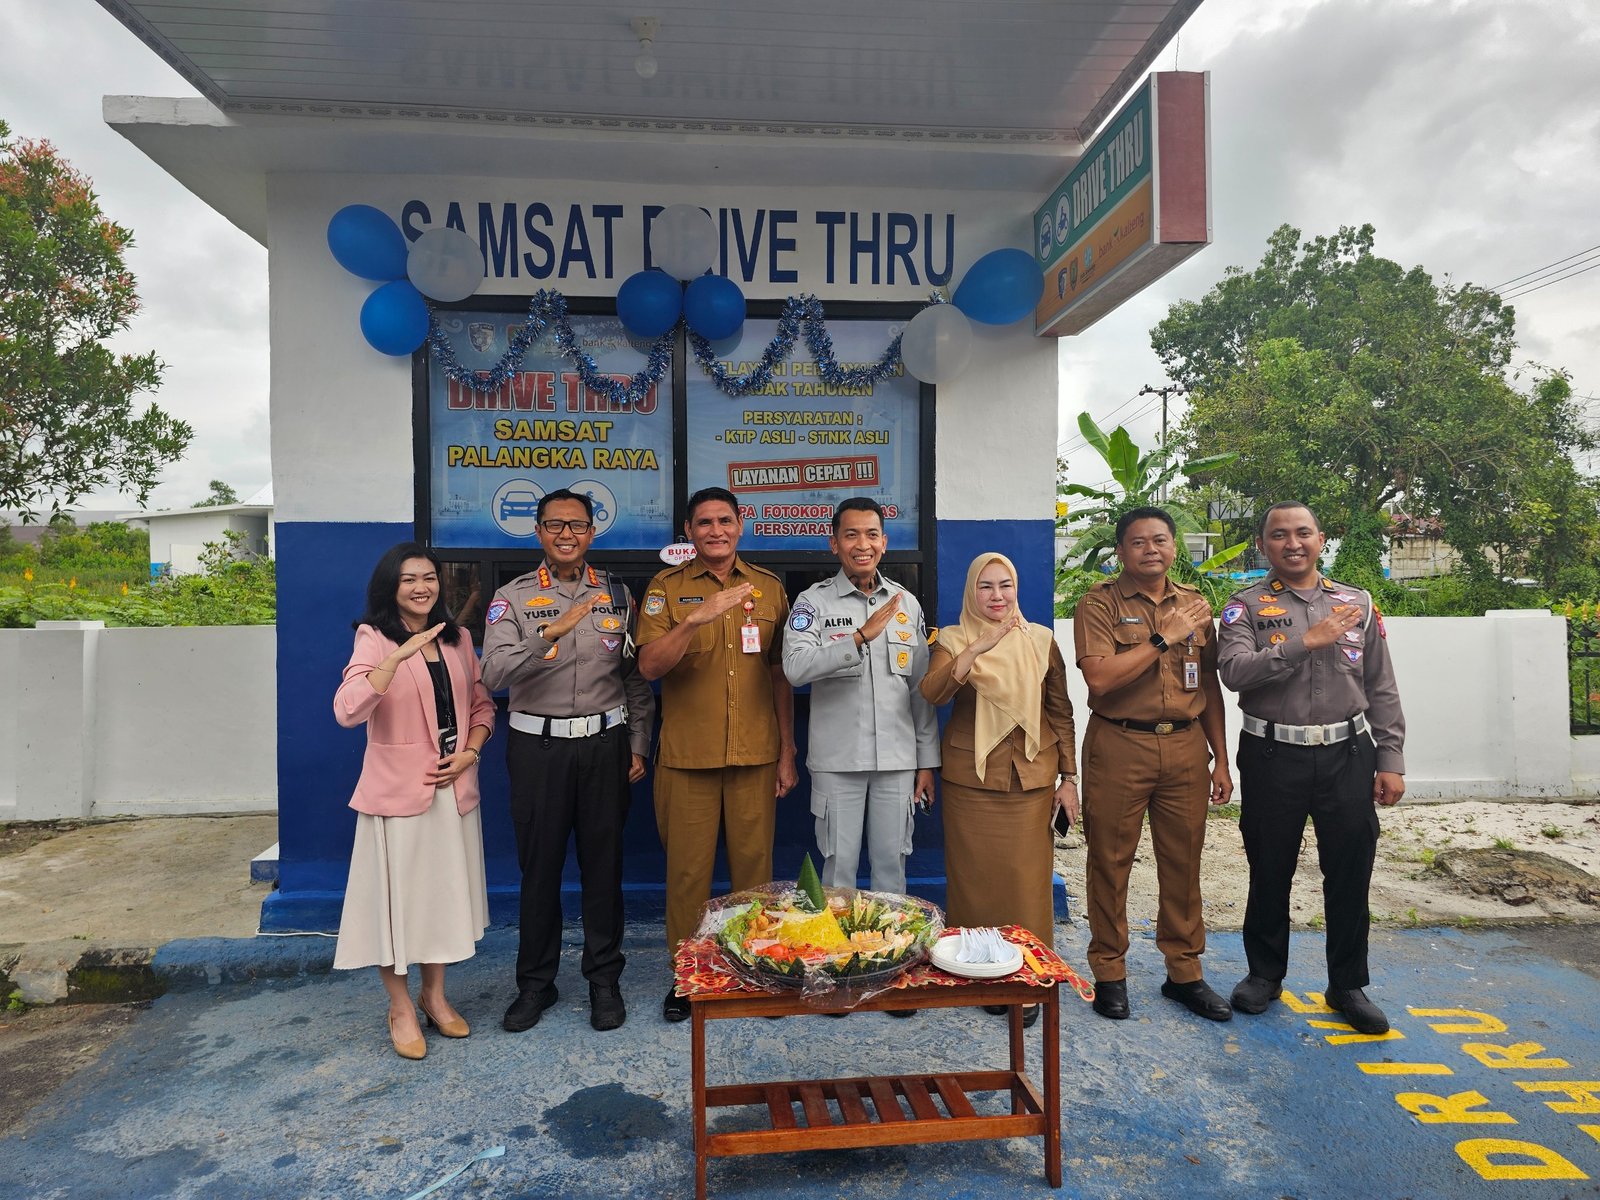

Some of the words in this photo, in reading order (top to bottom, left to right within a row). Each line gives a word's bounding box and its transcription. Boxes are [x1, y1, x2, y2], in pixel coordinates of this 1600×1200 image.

[1072, 150, 1107, 229] DRIVE
[1107, 108, 1144, 192] THRU
[643, 205, 798, 283] DIVE
[816, 210, 955, 287] THRU
[742, 410, 855, 426] PERSYARATAN
[494, 419, 614, 442] SAMSAT
[724, 430, 757, 444] KTP
[759, 430, 796, 444] ASLI
[807, 430, 853, 445] STNK
[854, 430, 890, 445] ASLI
[447, 446, 587, 469] PALANGKA
[593, 448, 660, 470] RAYA
[732, 466, 800, 487] LAYANAN
[804, 463, 852, 483] CEPAT
[762, 504, 834, 519] FOTOKOPI
[753, 522, 834, 536] PERSYARAT
[668, 548, 697, 556] BUKA
[523, 609, 561, 619] YUSEP
[591, 606, 622, 616] POLRI
[824, 617, 853, 628] ALFIN
[1257, 618, 1293, 630] BAYU
[1407, 1007, 1600, 1144] HRU
